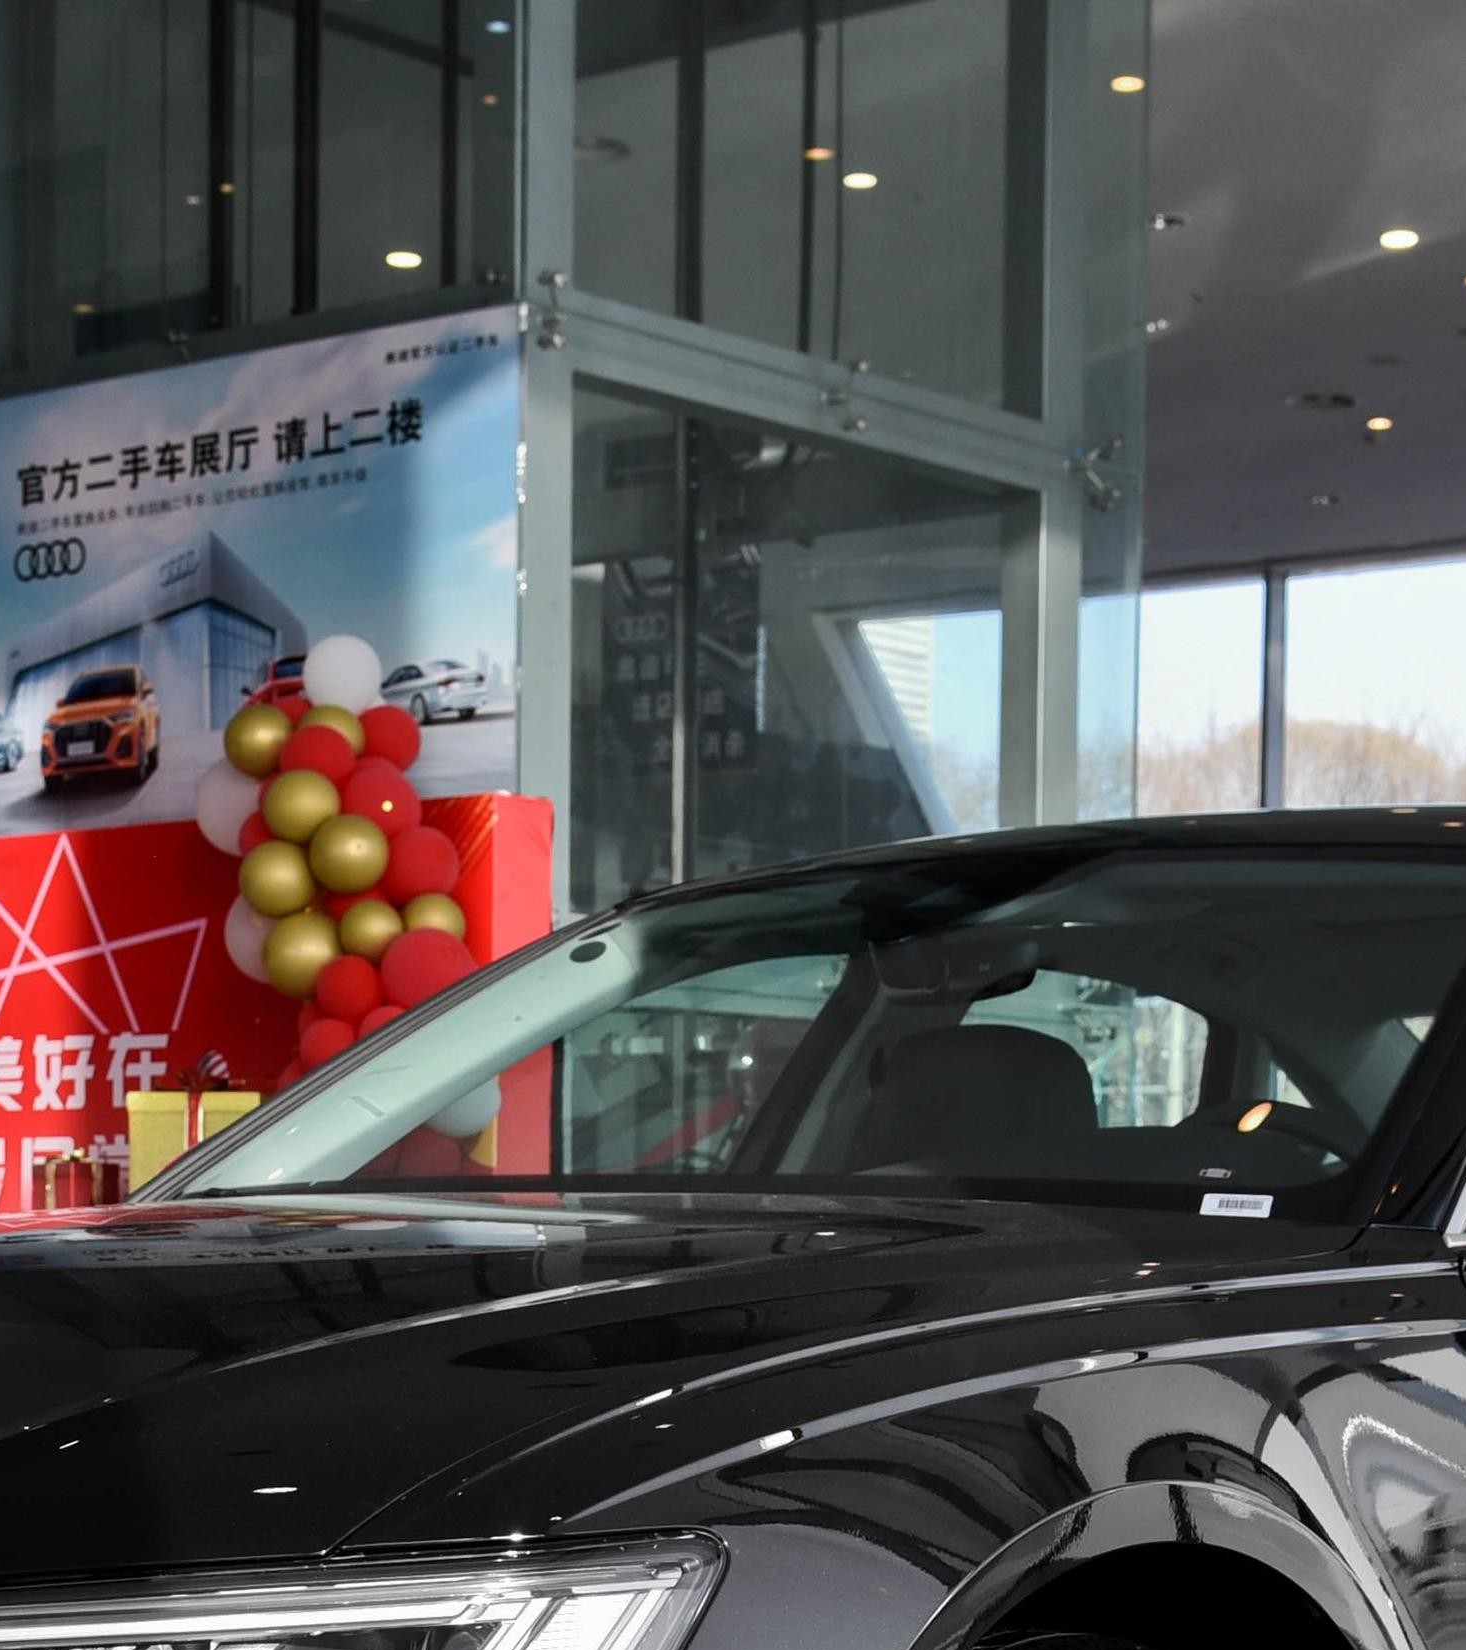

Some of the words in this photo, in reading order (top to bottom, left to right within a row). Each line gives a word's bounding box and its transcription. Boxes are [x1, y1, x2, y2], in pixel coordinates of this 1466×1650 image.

[17, 425, 260, 507] 官方二手车展厅
[274, 397, 424, 464] 请上二楼
